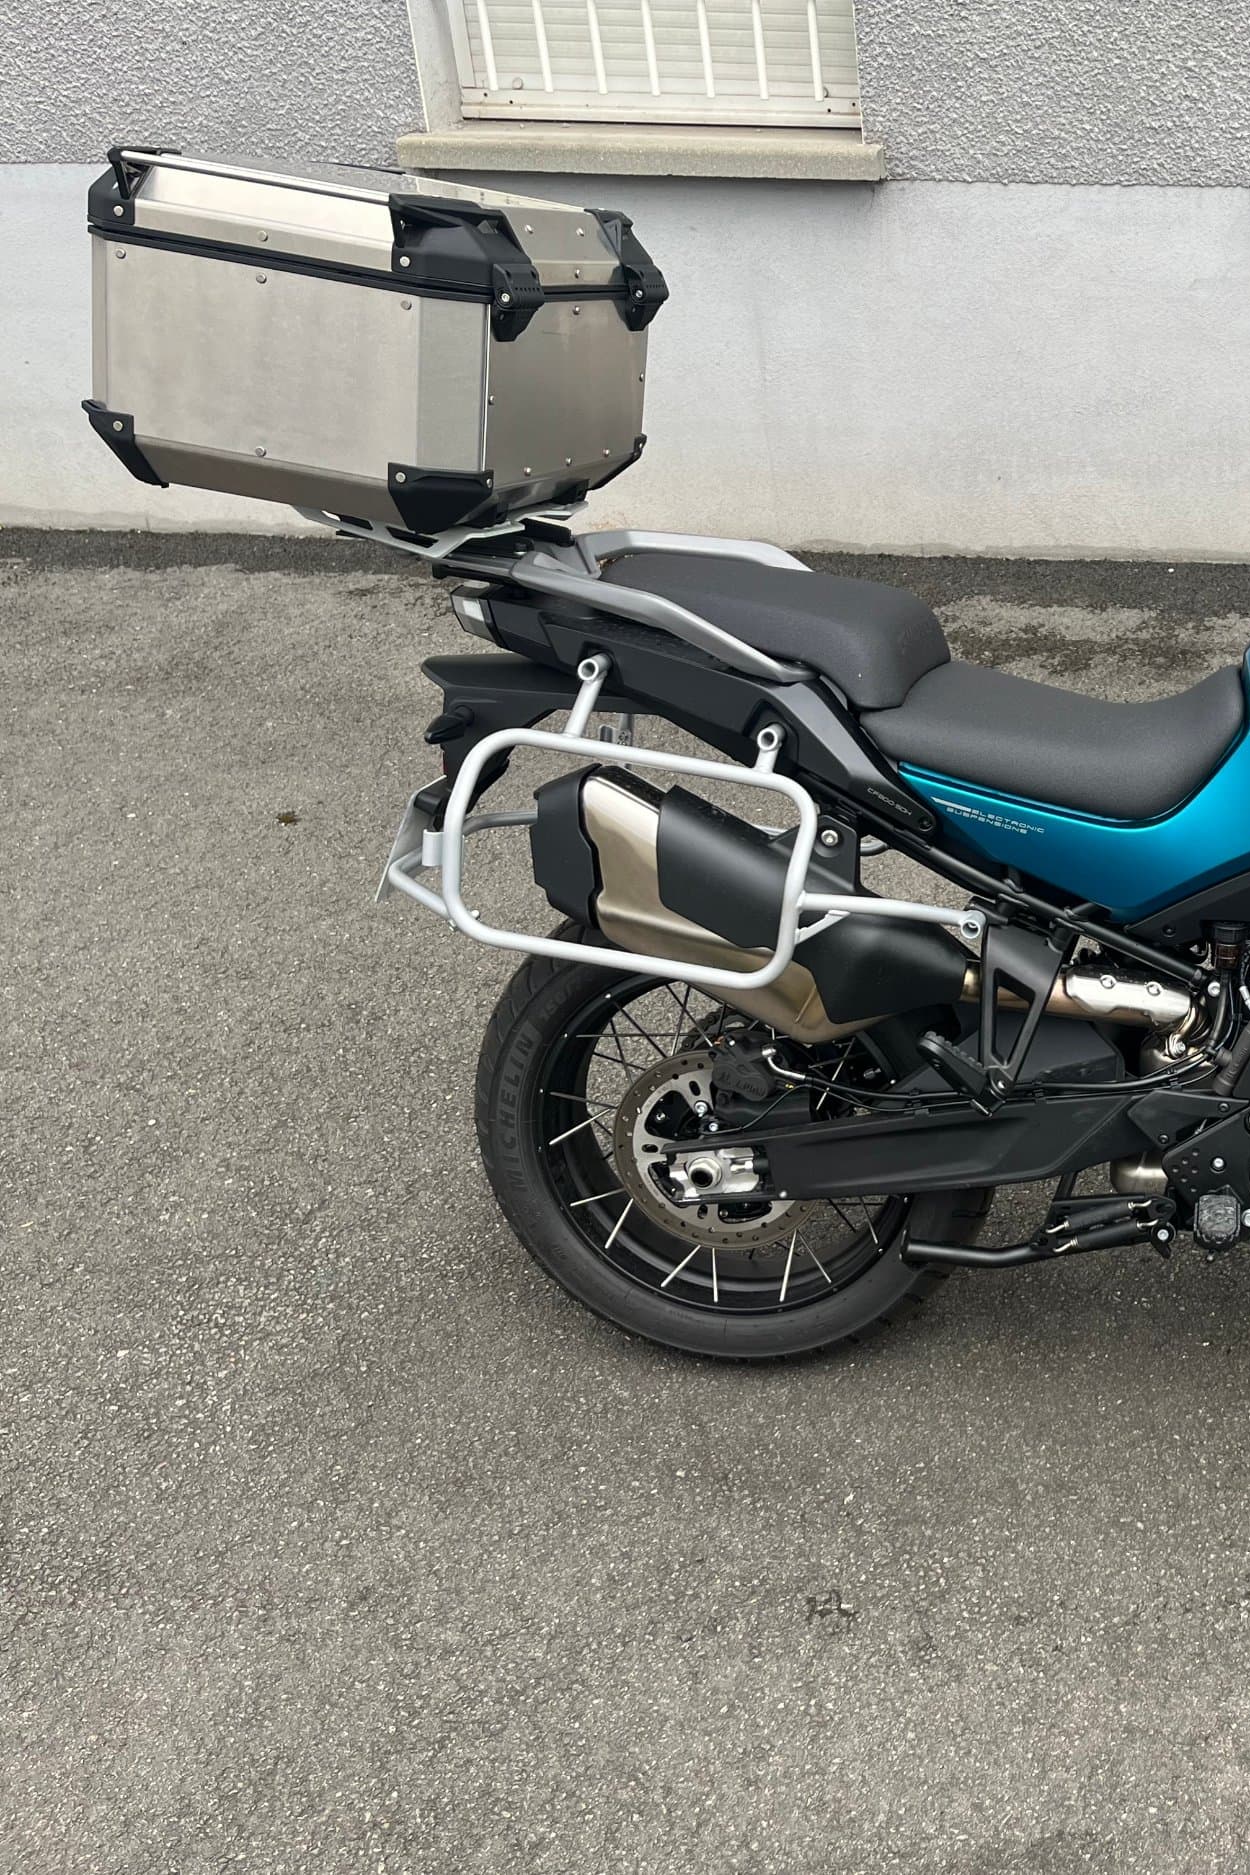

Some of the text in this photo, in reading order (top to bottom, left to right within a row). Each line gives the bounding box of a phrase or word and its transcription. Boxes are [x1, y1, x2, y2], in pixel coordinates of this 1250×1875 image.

[945, 806, 1029, 835] SUSPENSIONS
[970, 809, 1045, 834] ELECTRONIC
[498, 1036, 536, 1192] MICHELIN
